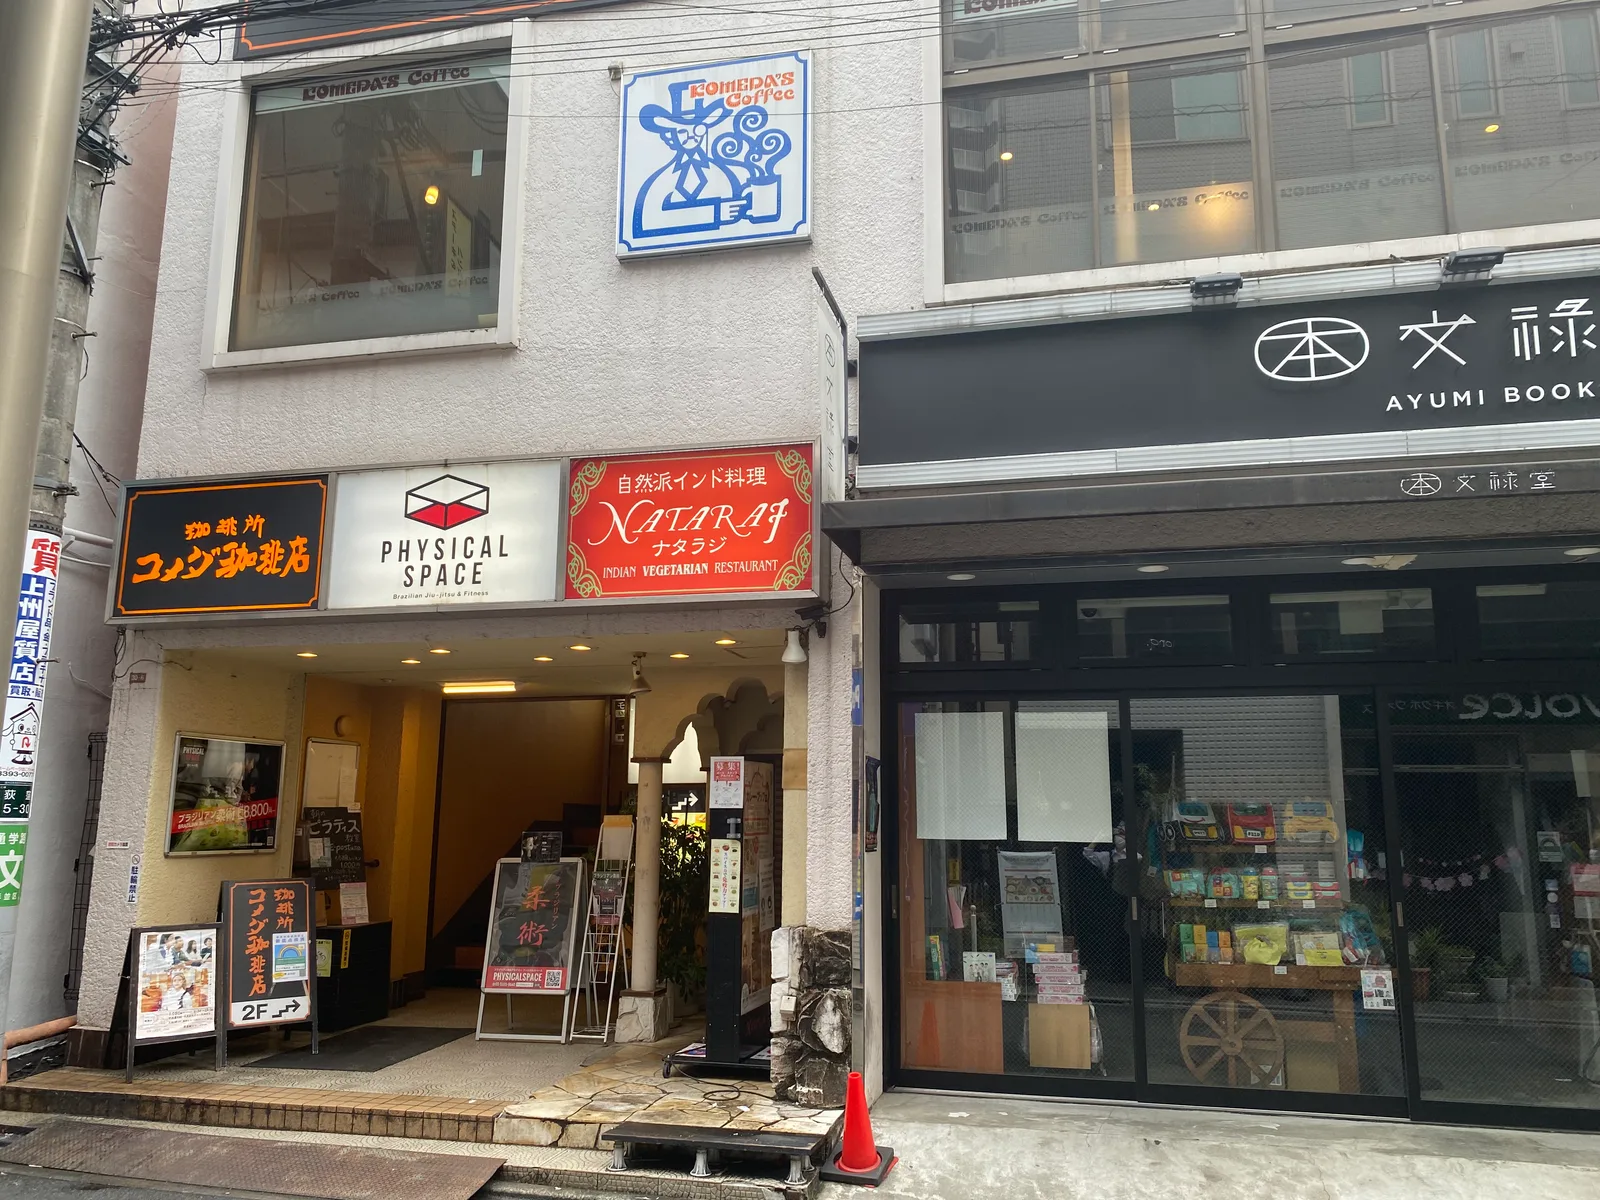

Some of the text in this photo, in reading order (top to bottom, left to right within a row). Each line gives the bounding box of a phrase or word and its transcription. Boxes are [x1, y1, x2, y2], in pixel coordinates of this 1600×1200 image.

[303, 67, 470, 101] KOMEDA'S Coffee
[690, 72, 795, 99] KOMEDA'S
[725, 88, 795, 108] Coffee
[1386, 381, 1600, 412] AYUMI BOOK
[618, 466, 767, 495] 自然派インド料理
[185, 514, 265, 541] 珈琲所
[588, 498, 789, 546] NATARAJ
[31, 538, 60, 578] 質
[131, 535, 311, 584] コメダ珈琲店
[381, 535, 509, 563] PHYSICAL
[652, 536, 728, 557] ナタラジ
[403, 562, 483, 587] SPACE
[603, 560, 778, 579] INDIAN VEGETARIAN RESTAURANT
[425, 591, 456, 599] Jiu-jitsu
[10, 576, 44, 684] 上州屋質店
[309, 818, 361, 835] ピラティス
[274, 888, 295, 933] 珈琲所
[516, 886, 550, 947] 柔術
[245, 889, 269, 997] コメダ珈琲店
[493, 972, 542, 982] PHYSICALSPACE
[241, 1003, 268, 1021] 2F
